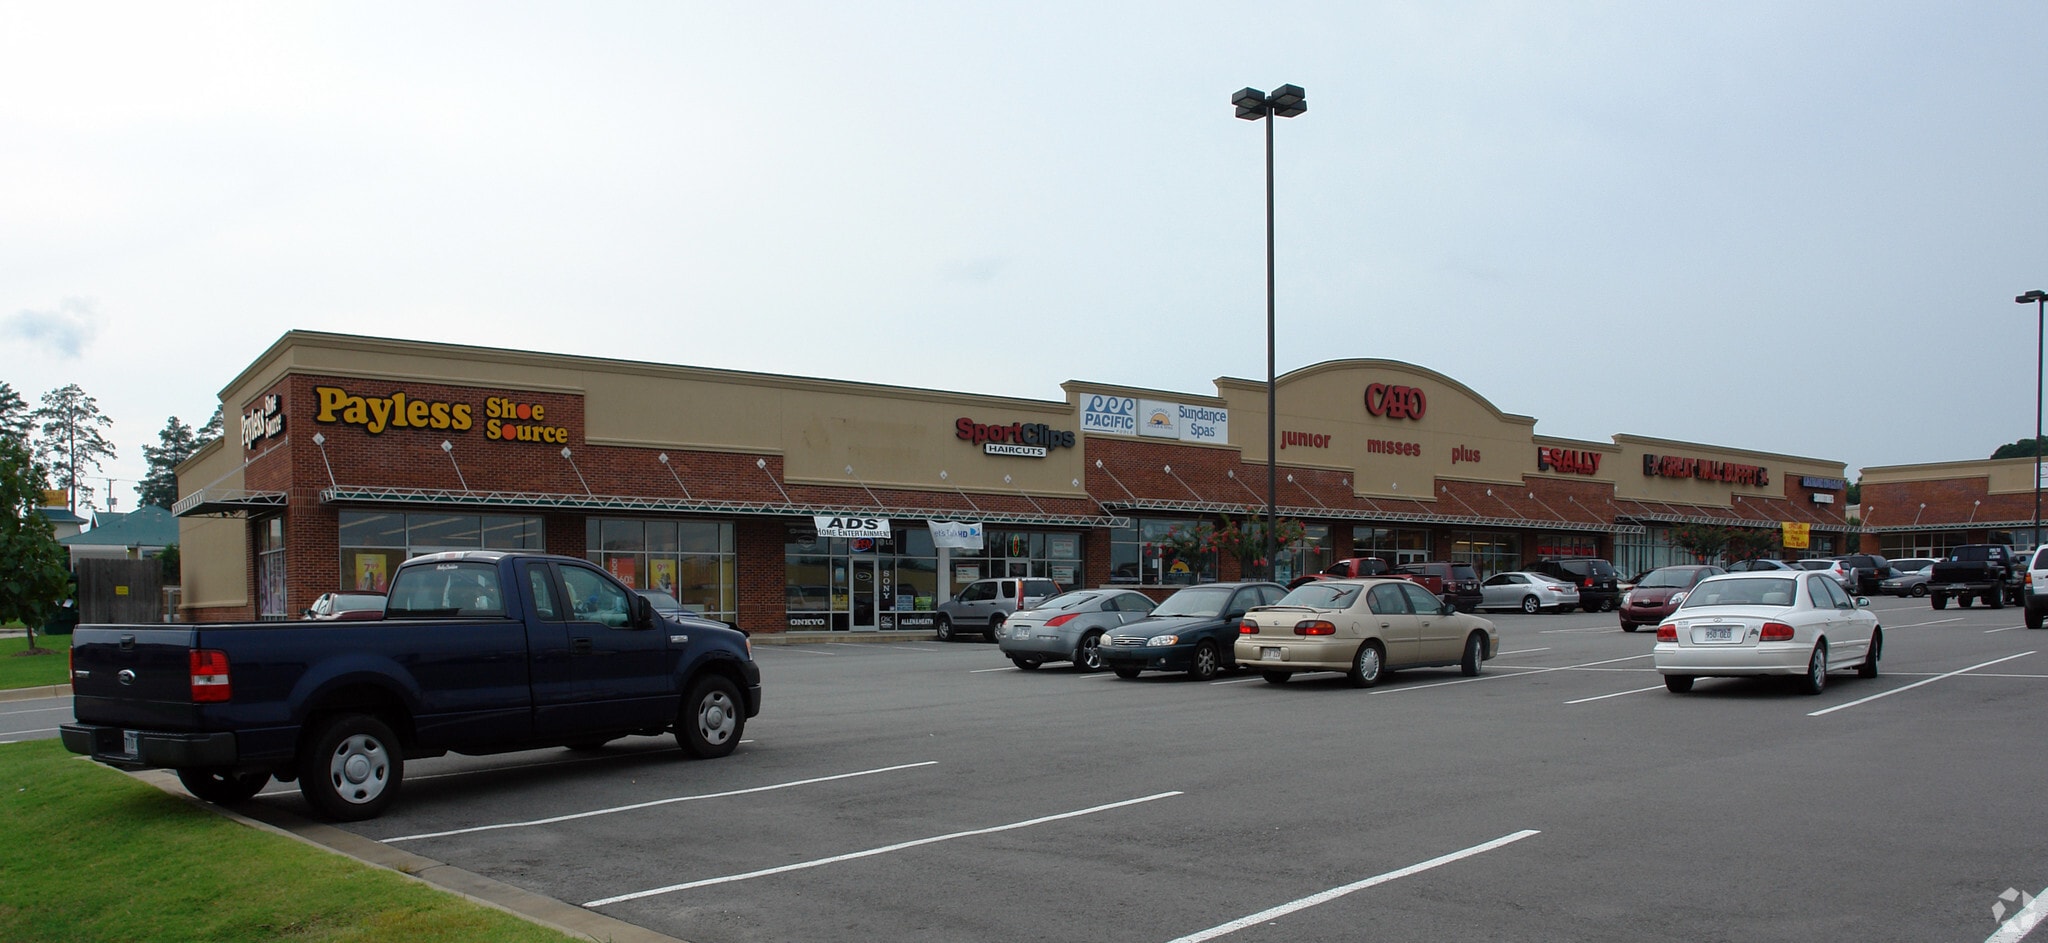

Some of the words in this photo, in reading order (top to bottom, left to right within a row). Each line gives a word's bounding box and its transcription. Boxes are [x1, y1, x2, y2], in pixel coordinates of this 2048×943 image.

[315, 386, 473, 434] Payless
[486, 396, 545, 420] Shoe
[1364, 382, 1426, 420] CATO
[1084, 412, 1134, 429] PACIFIC
[1179, 405, 1227, 423] Sundance
[486, 419, 568, 443] Source
[1190, 423, 1215, 438] Spas
[989, 445, 1043, 456] HAIRCUTS
[1280, 430, 1332, 449] junior
[1367, 439, 1421, 457] misses
[1452, 444, 1481, 465] plus
[1551, 447, 1602, 471] SALLY
[827, 517, 879, 530] ADS
[790, 618, 825, 626] ONKYO
